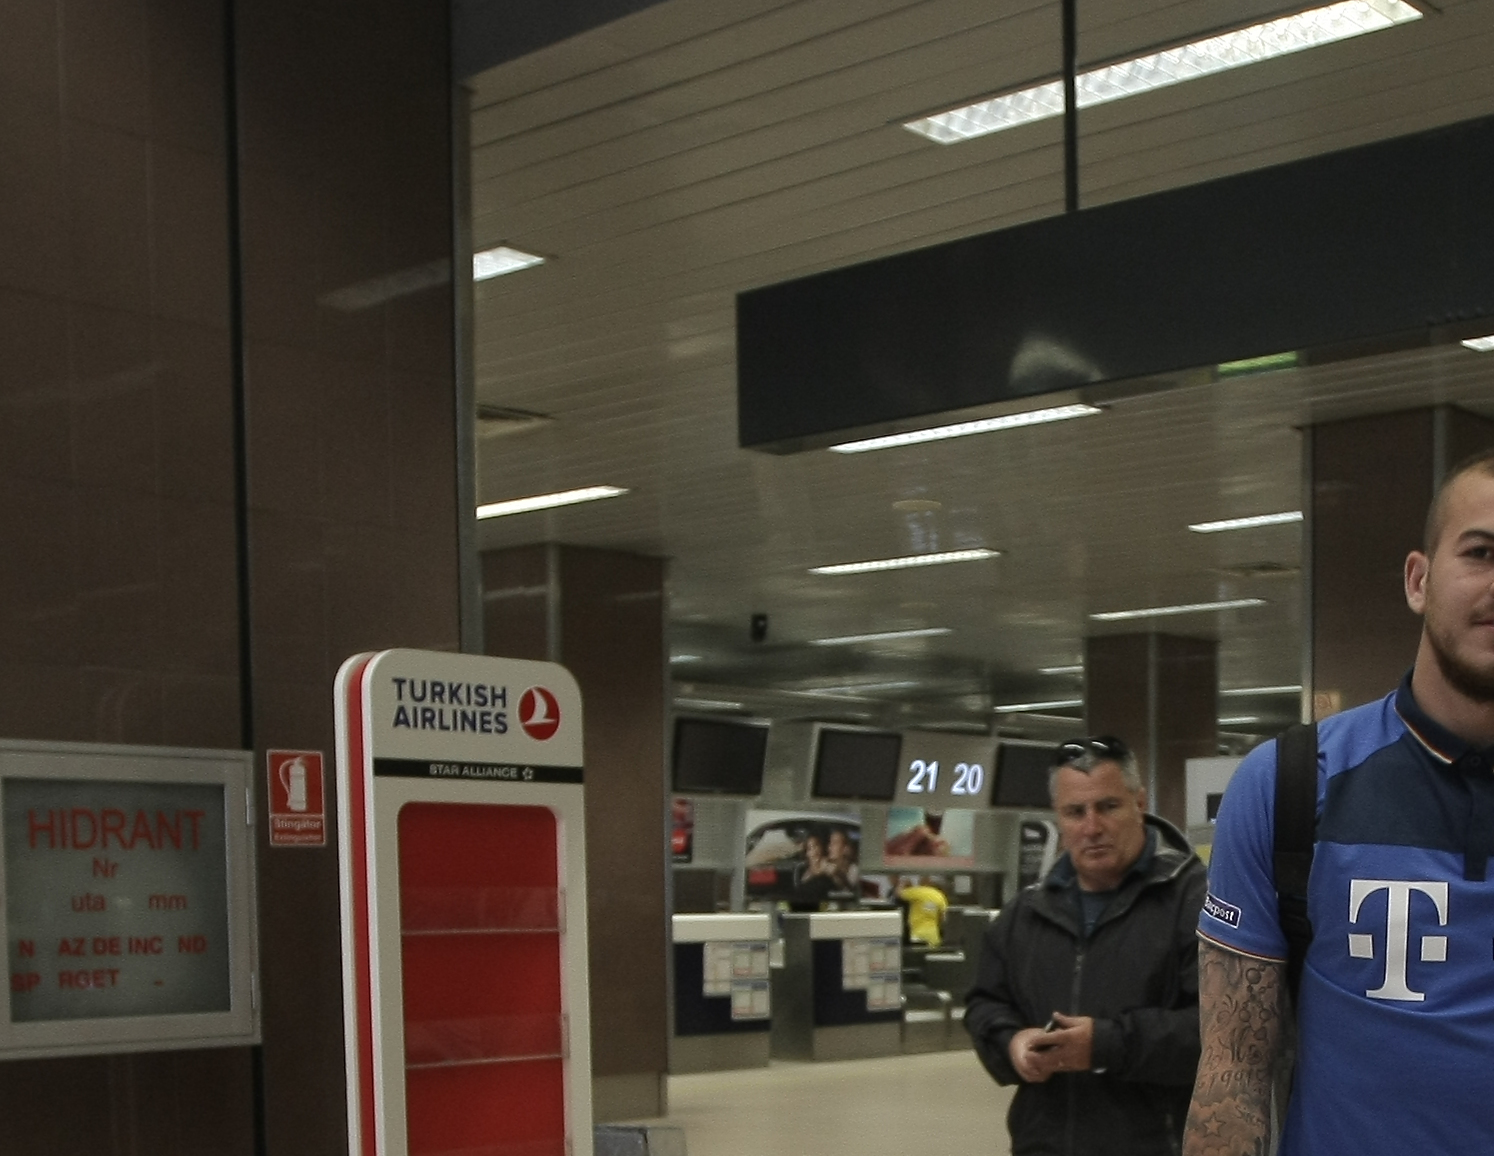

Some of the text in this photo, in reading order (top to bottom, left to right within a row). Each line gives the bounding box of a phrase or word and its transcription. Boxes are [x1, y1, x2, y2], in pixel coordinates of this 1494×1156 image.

[392, 678, 507, 708] TURKISH
[393, 705, 508, 734] AIRLINES
[429, 764, 518, 779] STAR ALLIANCE
[907, 760, 984, 795] 21 20
[27, 808, 206, 850] HIDRANT
[92, 857, 119, 878] Nr
[149, 894, 188, 910] mm
[92, 937, 121, 955] DE
